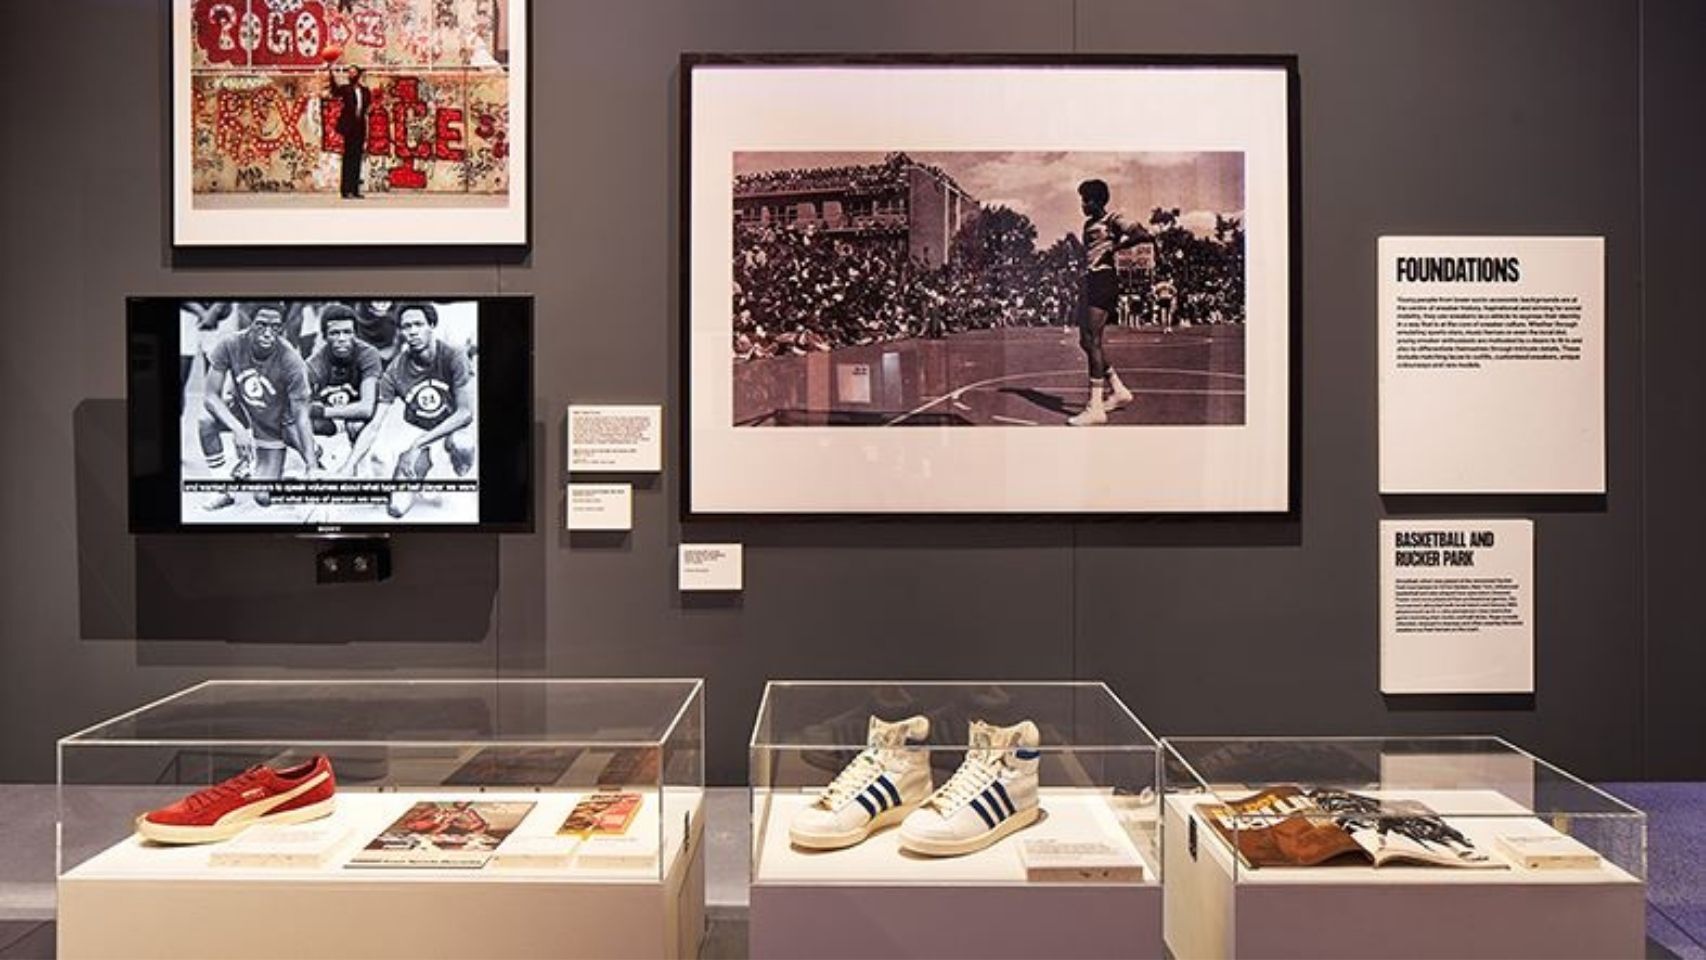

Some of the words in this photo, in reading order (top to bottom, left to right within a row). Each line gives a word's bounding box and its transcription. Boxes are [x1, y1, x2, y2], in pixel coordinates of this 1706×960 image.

[1396, 257, 1520, 282] FOUNDATIONS
[1395, 531, 1466, 548] BASKETBALL
[1470, 531, 1494, 547] AND
[1395, 550, 1440, 566] RUCKER
[1443, 550, 1474, 566] PARK
